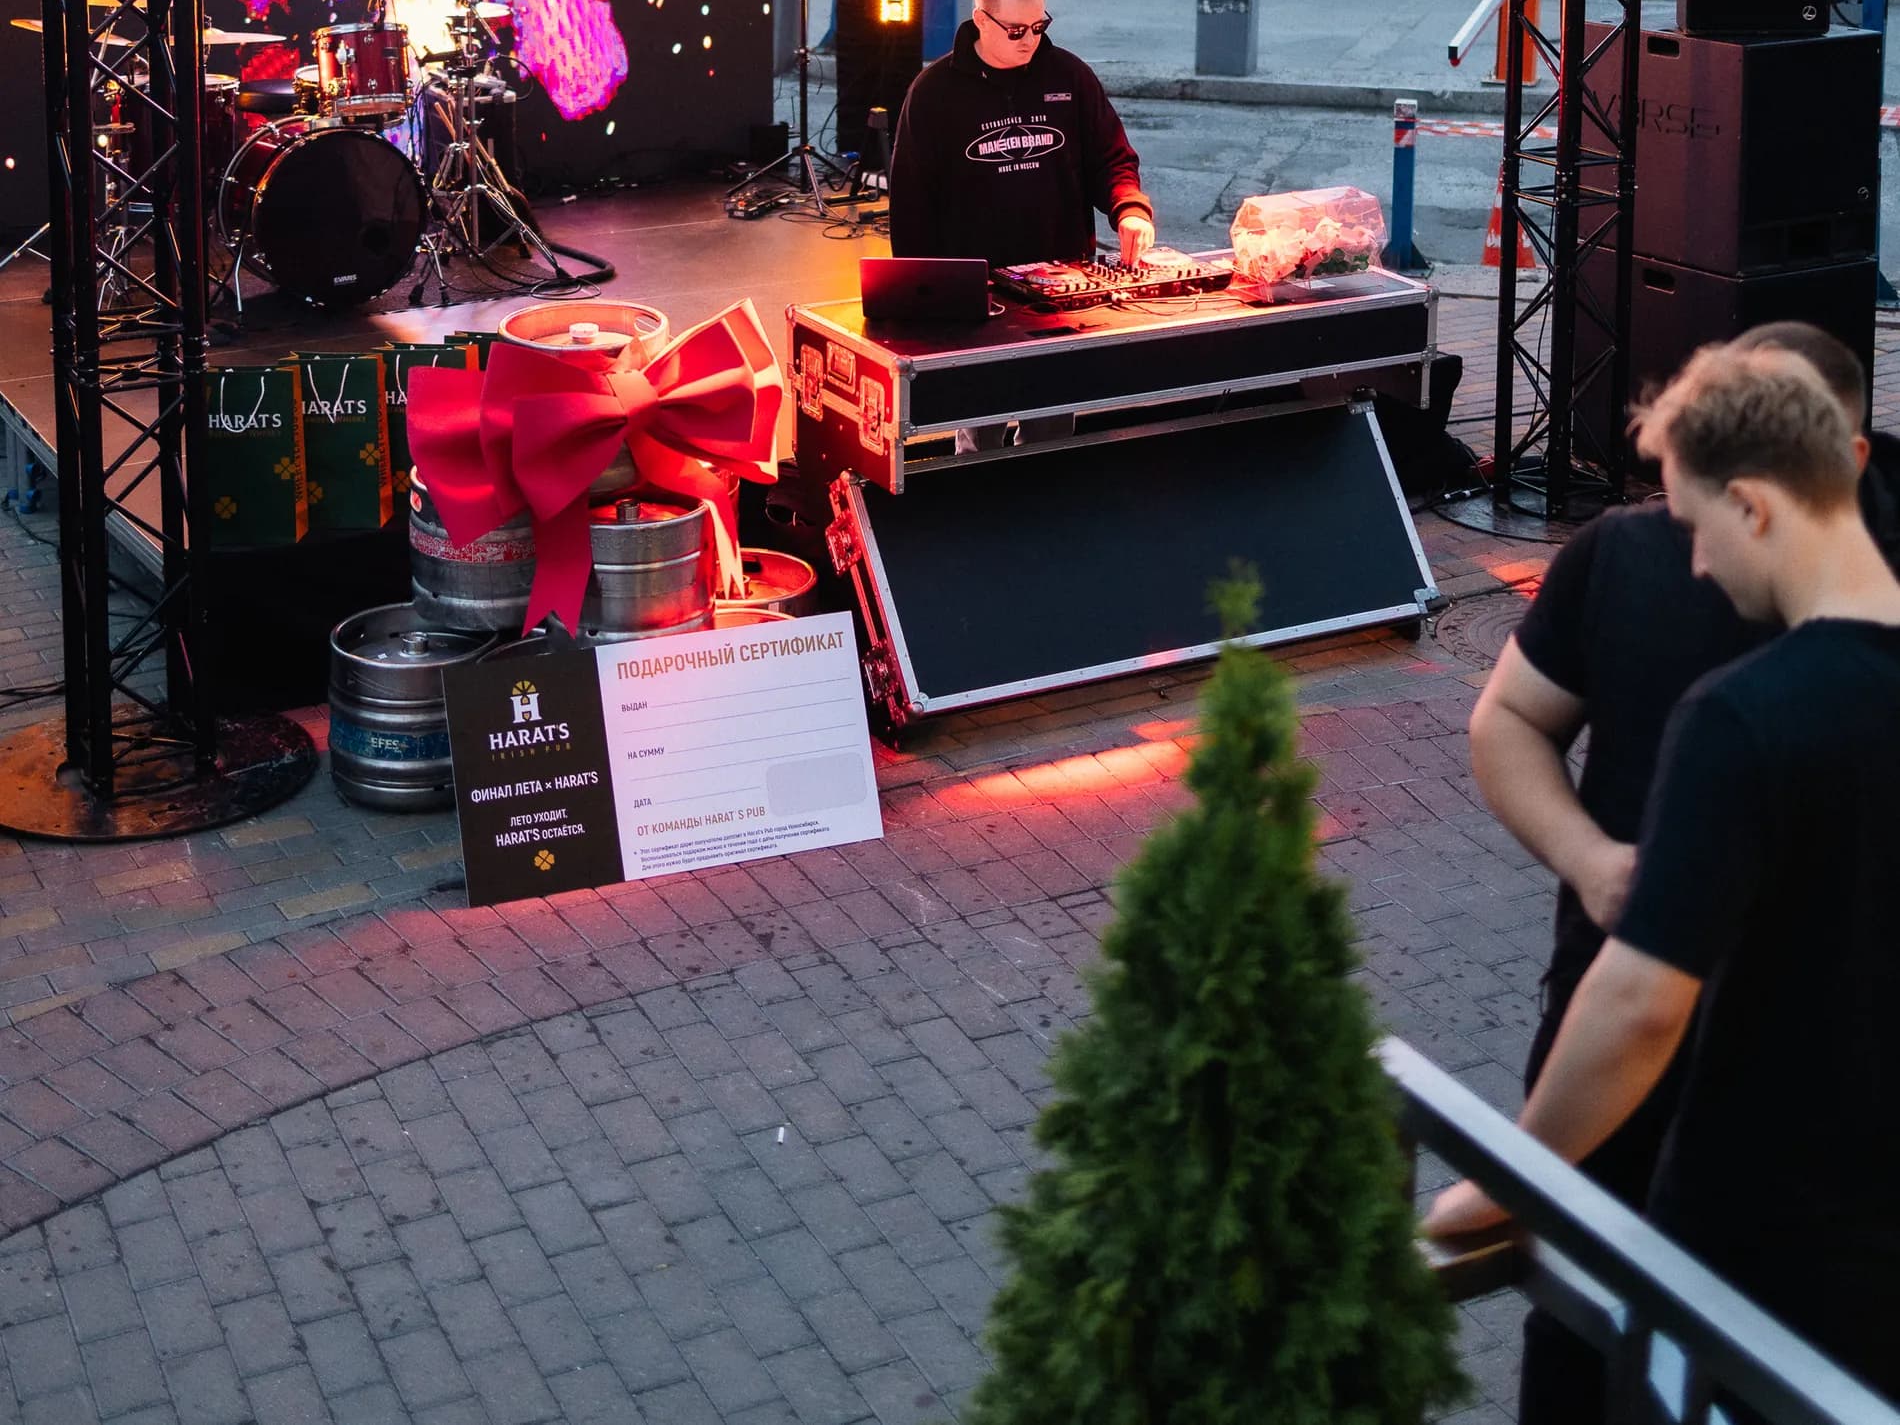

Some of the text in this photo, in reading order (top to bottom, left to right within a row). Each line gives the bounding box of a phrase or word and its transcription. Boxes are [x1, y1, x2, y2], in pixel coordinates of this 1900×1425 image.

[1591, 91, 1720, 139] VRSE
[1022, 133, 1054, 149] BRAND
[617, 631, 844, 680] ПОДАРОЧНЫЙ СЕРТИФИКАТ
[621, 701, 648, 712] ВЫДАН
[370, 737, 400, 750] EFES
[491, 742, 571, 762] IRISH PUB
[627, 746, 665, 760] НА СУММУ
[471, 784, 512, 803] ФИНАЛ
[515, 780, 543, 796] ЛЕТА
[554, 771, 599, 790] HARAT'S
[633, 798, 652, 809] ДАТА
[510, 808, 568, 827] ЛЕТО УХОДИТ.
[637, 824, 649, 837] ОТ
[652, 816, 703, 834] КОМАНДЫ
[746, 806, 766, 818] PUB
[495, 823, 585, 847] HARAT'S ОСТАЁТСЯ.
